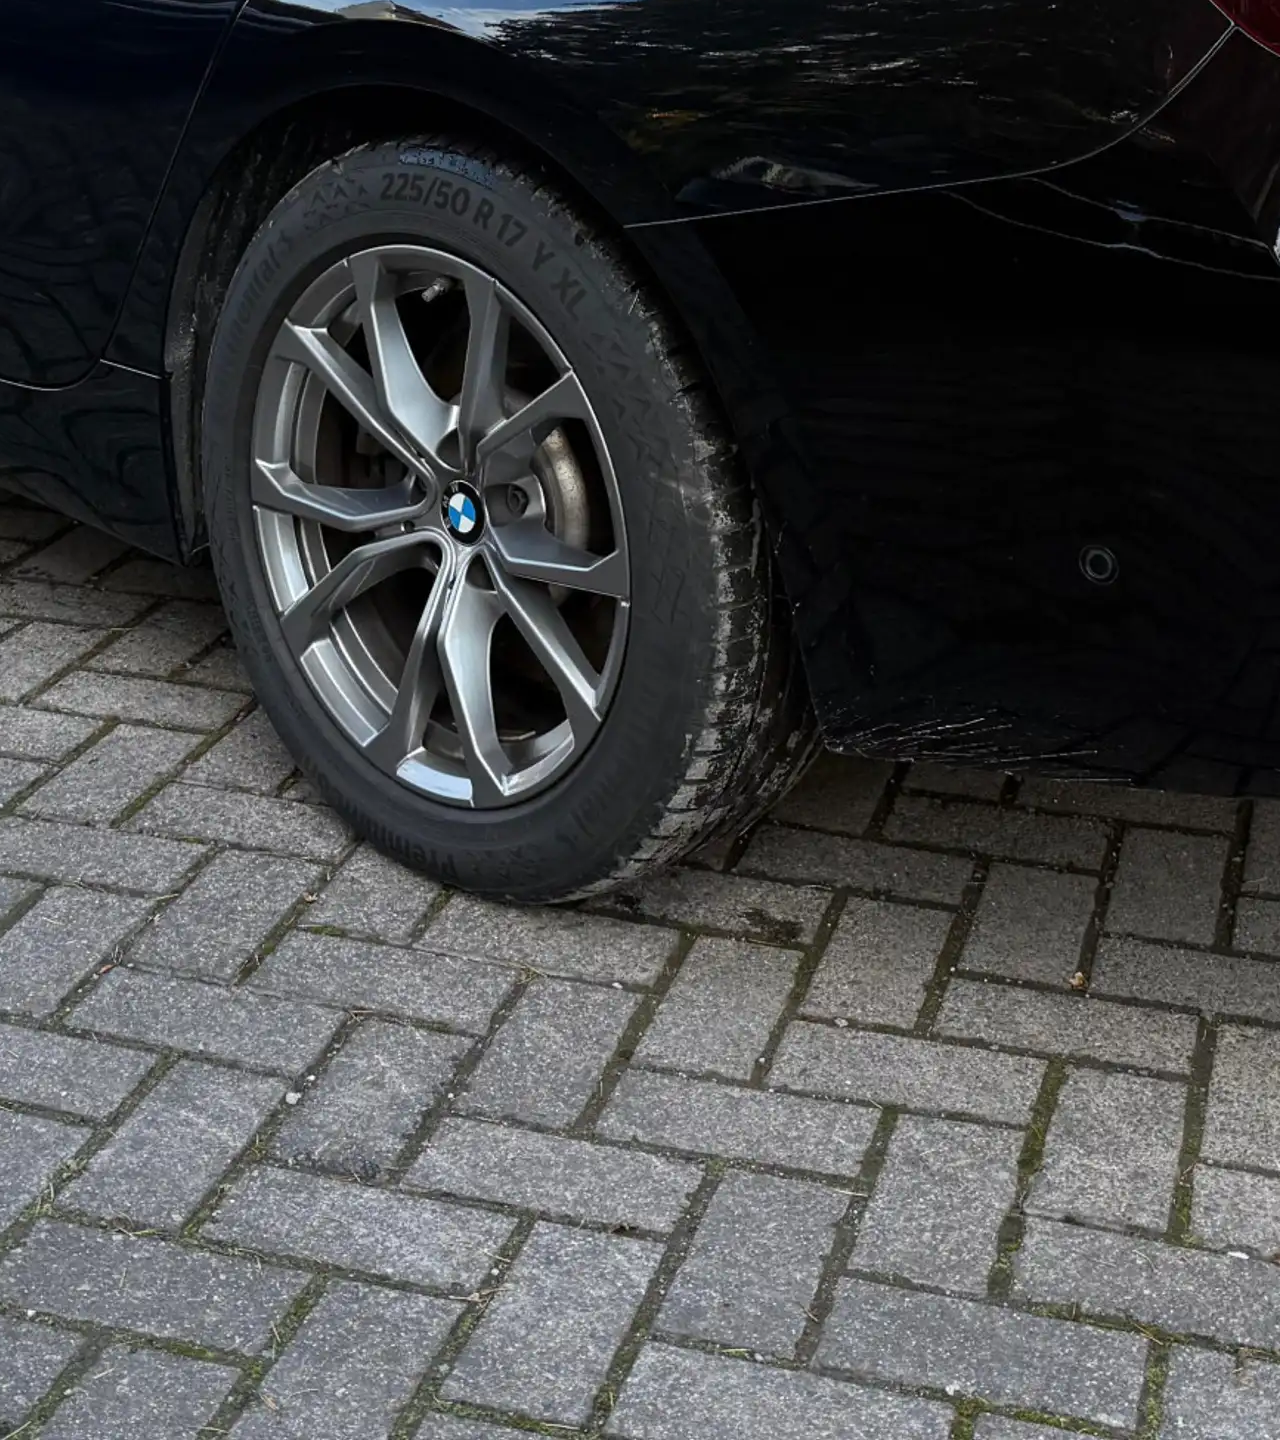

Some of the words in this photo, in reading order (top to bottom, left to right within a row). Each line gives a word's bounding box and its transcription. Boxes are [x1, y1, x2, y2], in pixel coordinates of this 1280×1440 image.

[380, 171, 470, 217] 225/50
[472, 197, 495, 231] R
[496, 213, 528, 248] 17
[532, 240, 556, 273] Y
[551, 267, 588, 321] XL
